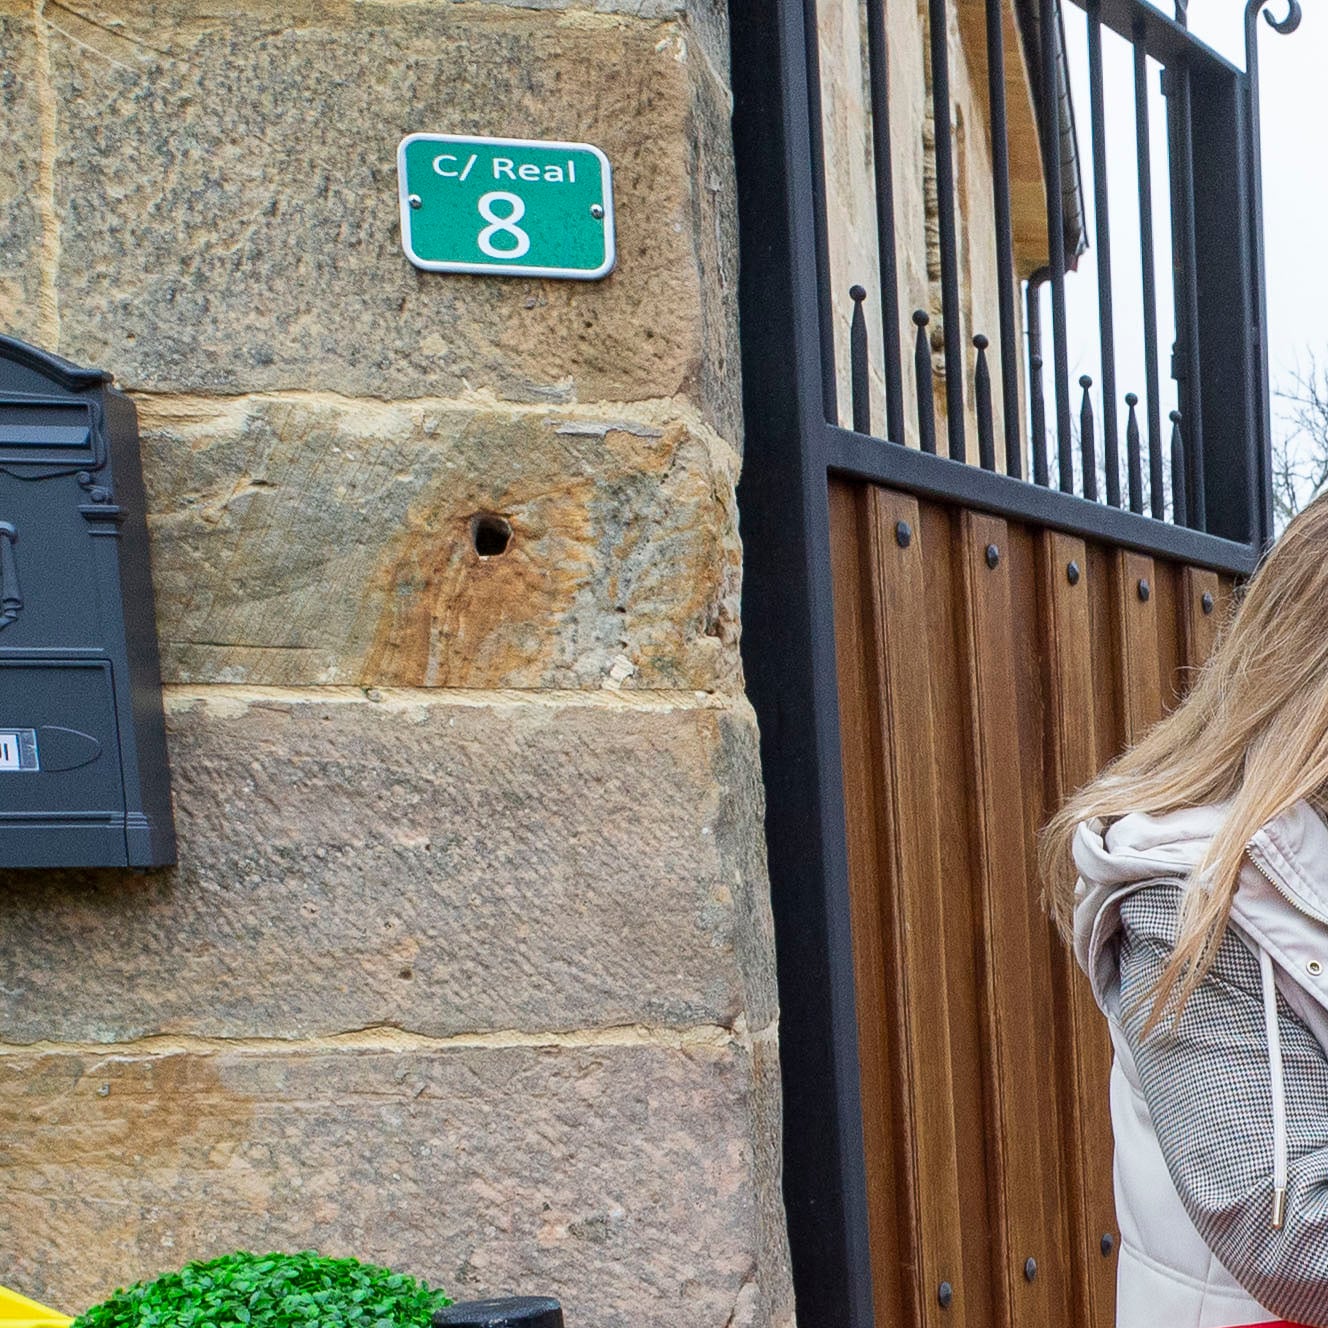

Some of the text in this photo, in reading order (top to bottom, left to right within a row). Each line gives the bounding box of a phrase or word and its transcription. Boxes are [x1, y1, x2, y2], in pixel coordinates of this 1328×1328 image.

[432, 154, 576, 183] C/ Real
[477, 191, 531, 259] 8
